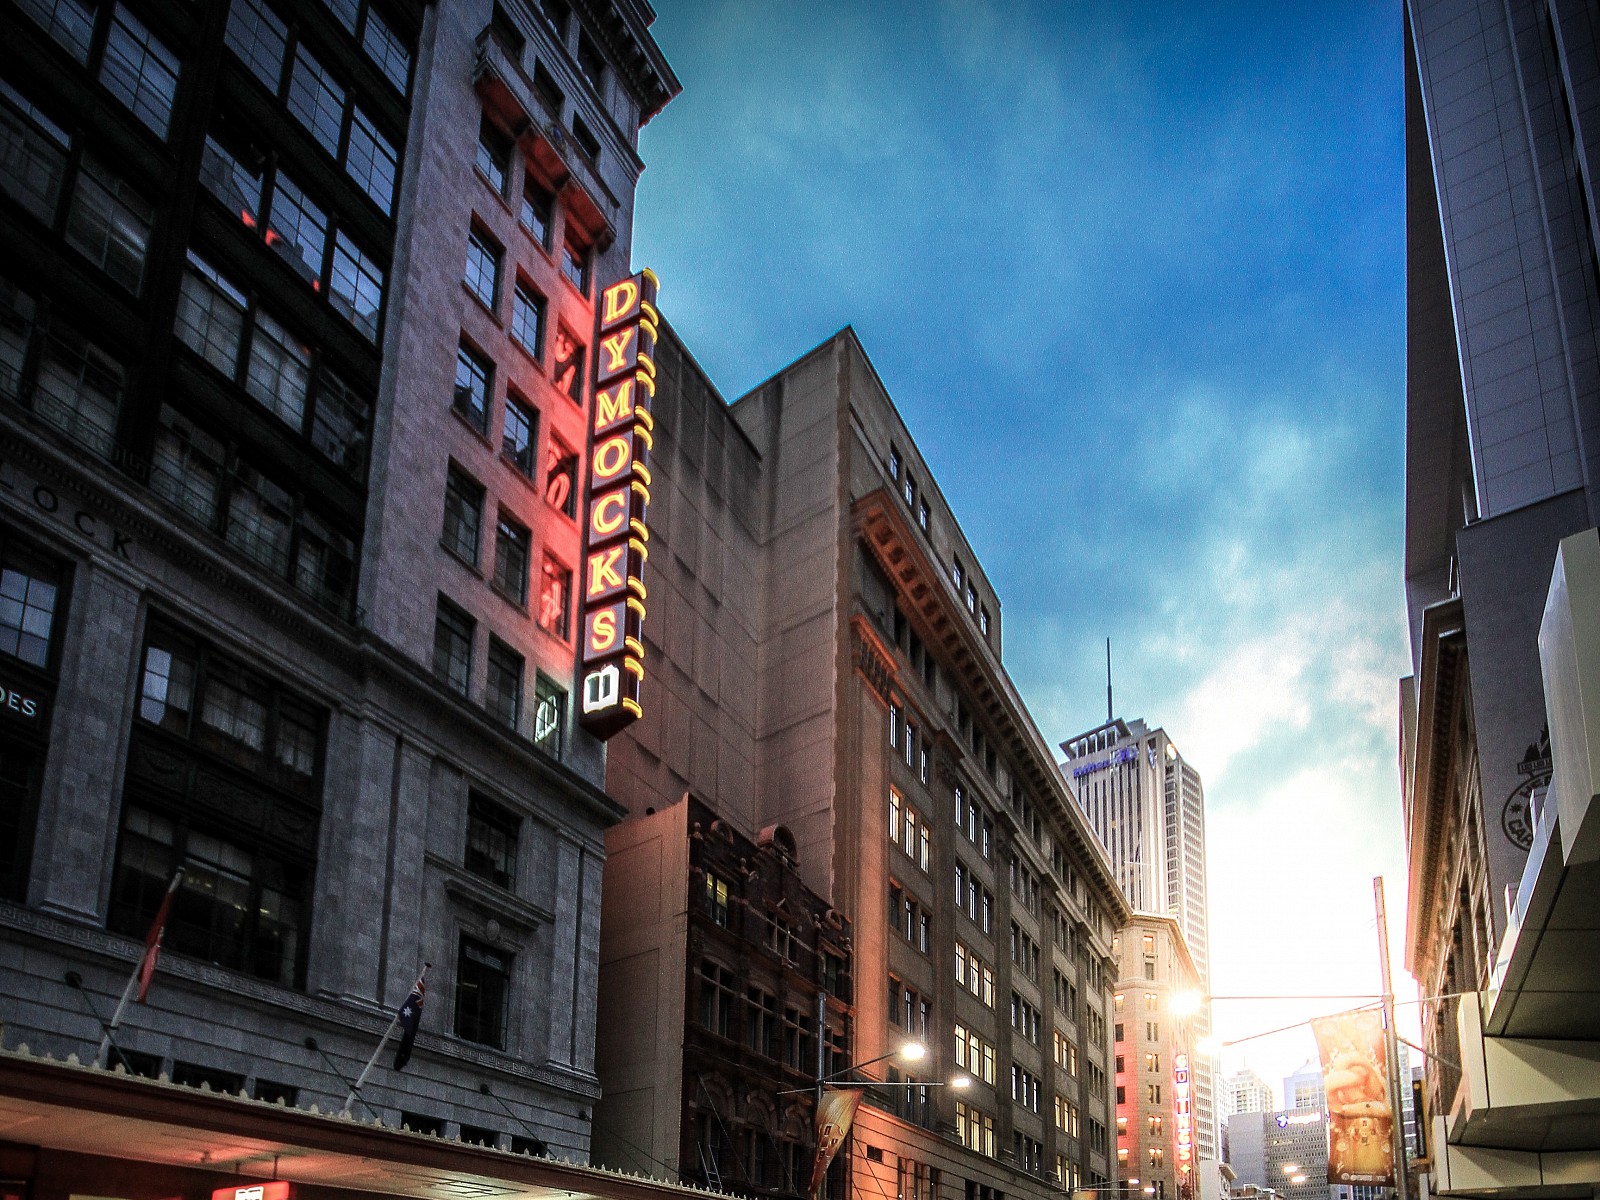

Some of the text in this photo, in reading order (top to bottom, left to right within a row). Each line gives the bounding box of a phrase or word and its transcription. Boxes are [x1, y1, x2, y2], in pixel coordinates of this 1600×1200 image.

[590, 281, 639, 651] DYMOCKS
[0, 479, 132, 560] OCK
[1175, 1054, 1191, 1160] GOWINGS
